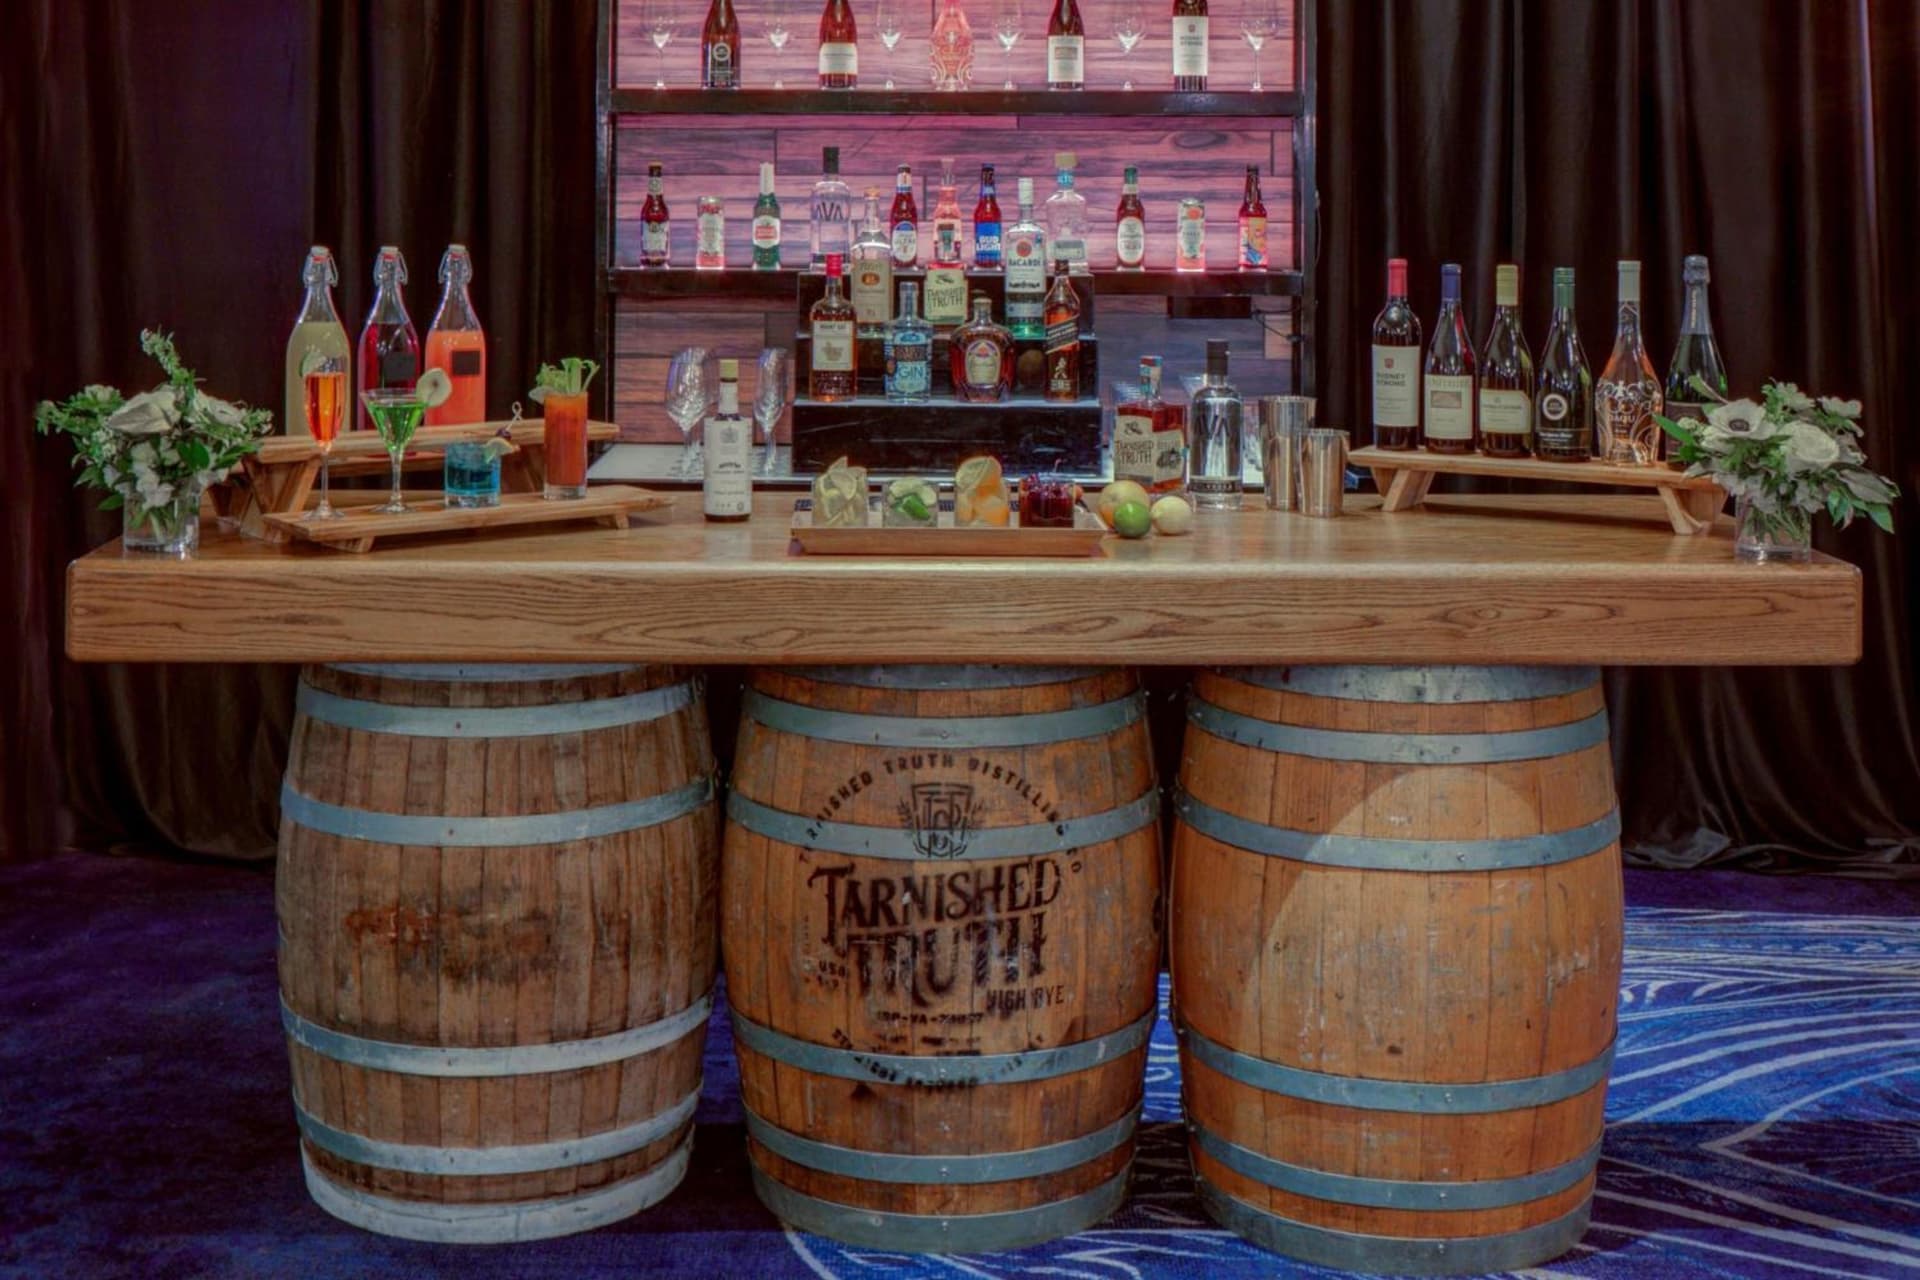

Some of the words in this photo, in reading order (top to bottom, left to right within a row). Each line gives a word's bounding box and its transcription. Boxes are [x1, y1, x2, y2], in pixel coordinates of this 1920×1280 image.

[976, 243, 1001, 251] LIGHT
[979, 235, 1000, 244] BUD
[1008, 258, 1041, 267] BACARDI
[901, 363, 924, 379] GIN
[1119, 450, 1152, 465] TRUTH
[883, 753, 954, 775] TRUTH
[807, 857, 1062, 947] TARNISHED
[847, 911, 1048, 1008] TRUTH
[986, 988, 1026, 1011] HIGH
